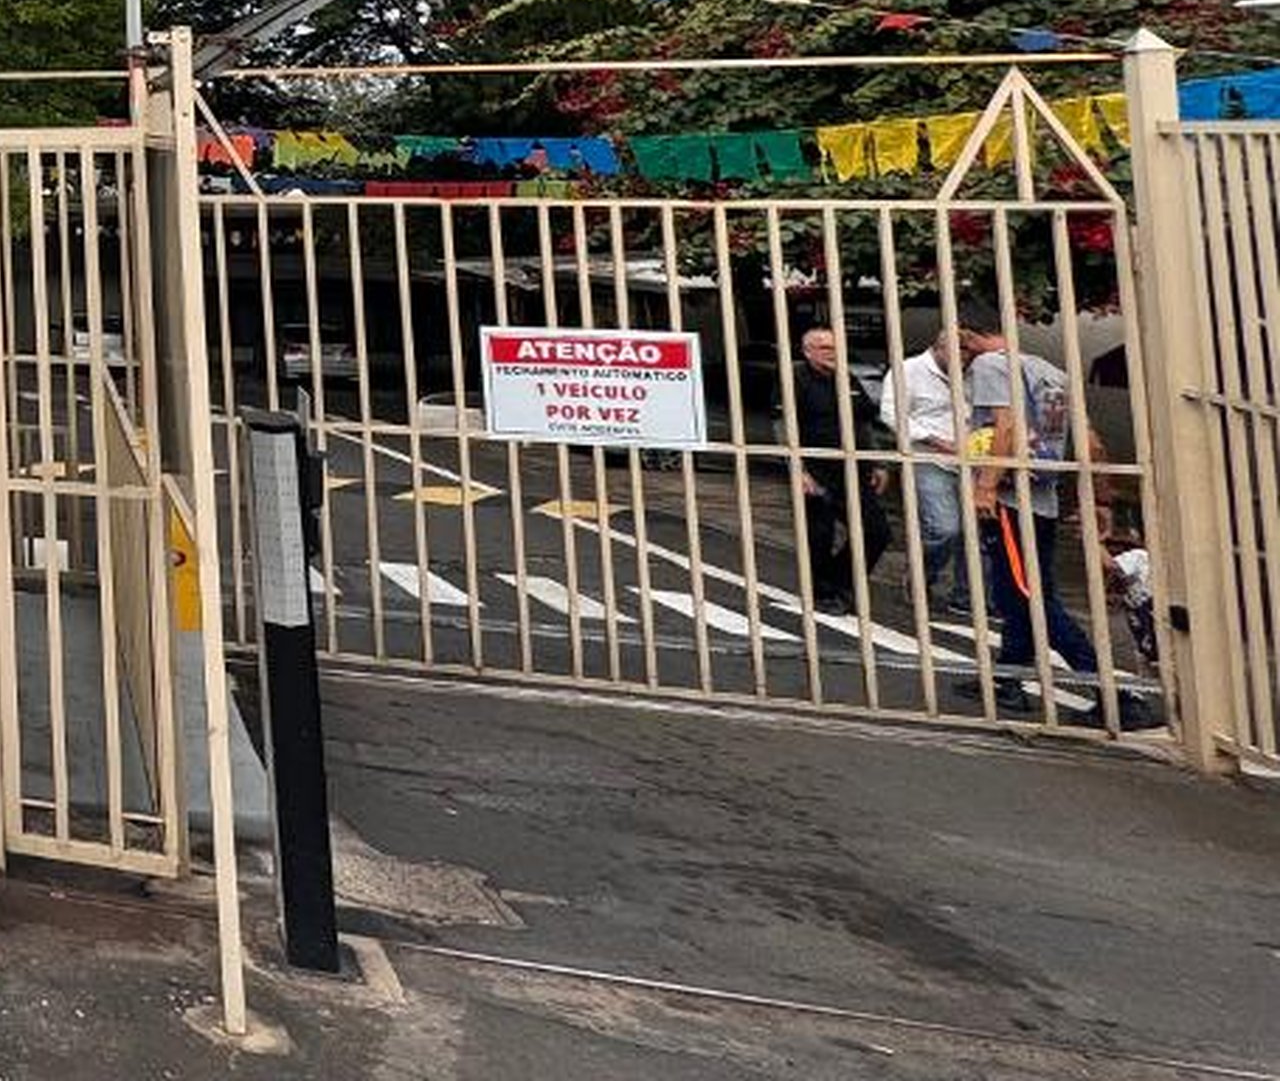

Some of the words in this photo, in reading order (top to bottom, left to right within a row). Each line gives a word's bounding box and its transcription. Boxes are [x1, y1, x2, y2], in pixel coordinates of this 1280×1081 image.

[517, 339, 662, 363] ATENÇÃO
[536, 382, 546, 396] 1
[546, 404, 591, 420] POR
[598, 407, 641, 423] VEZ
